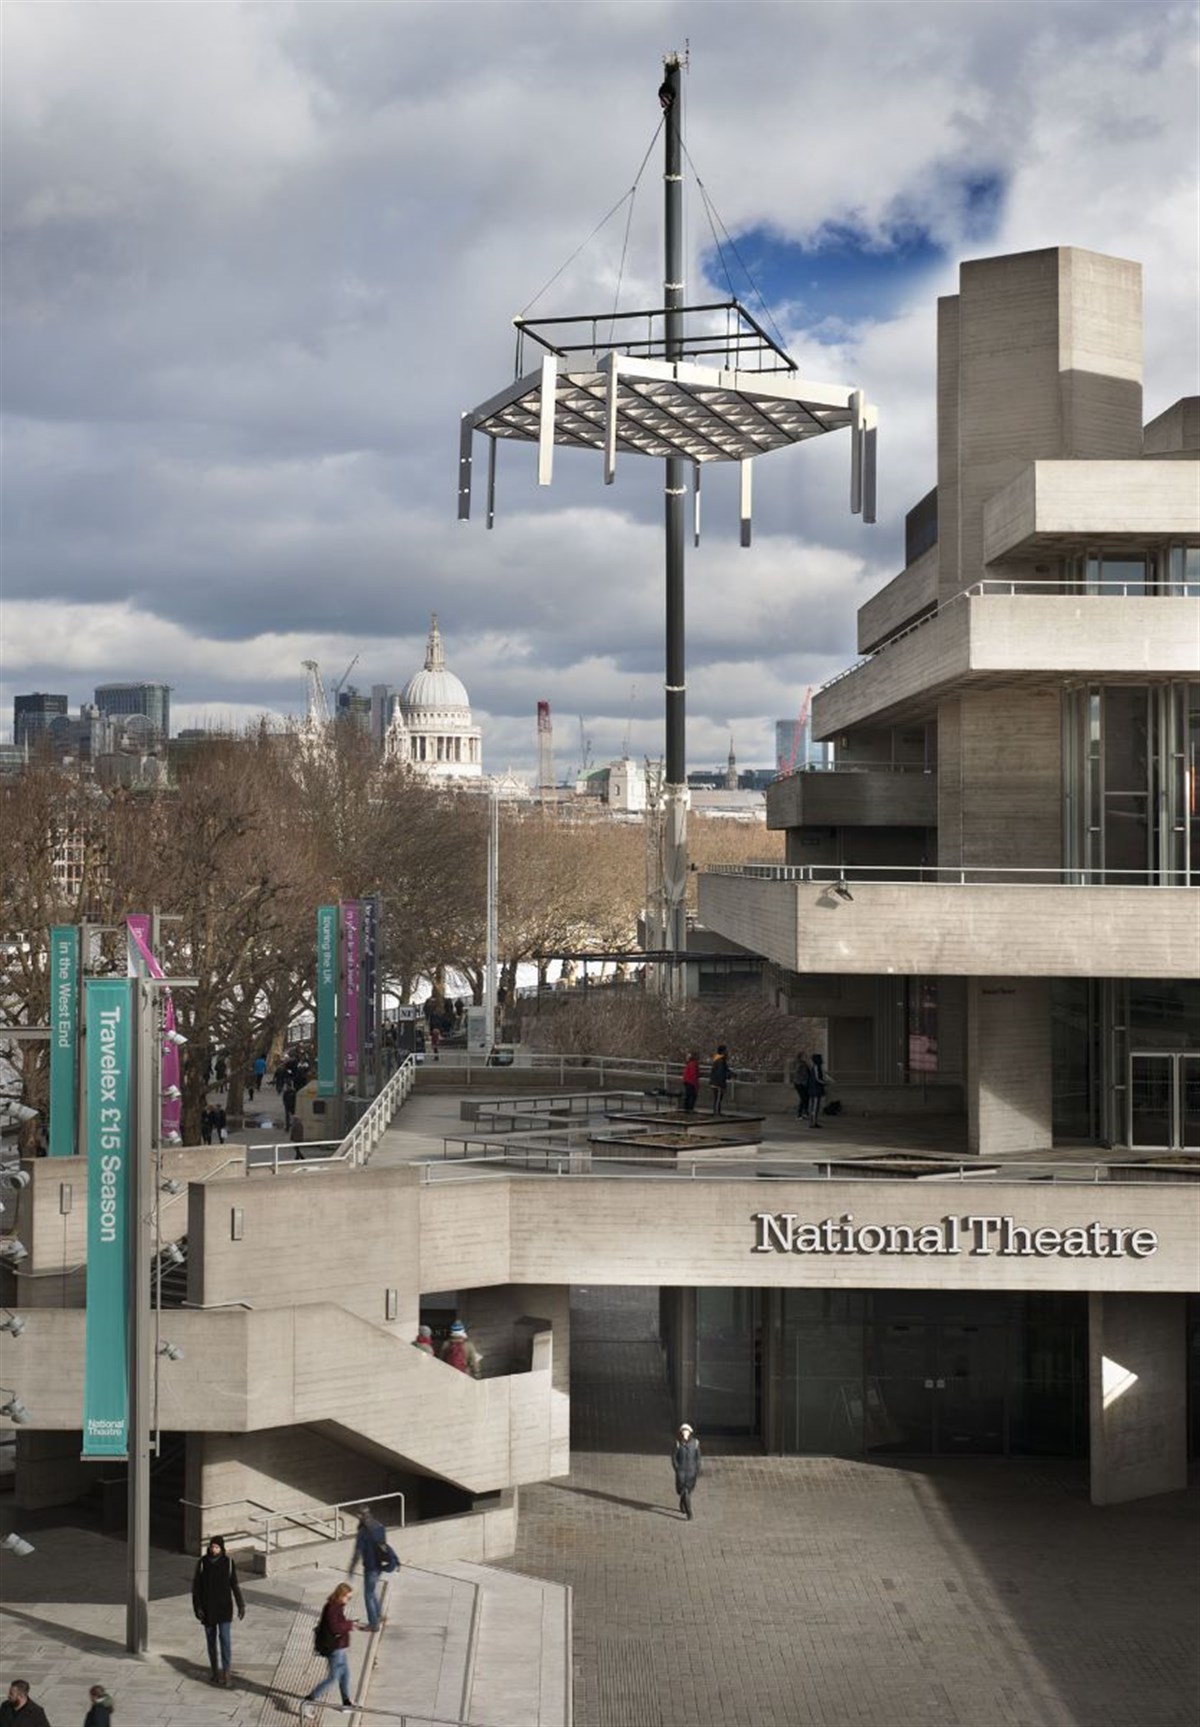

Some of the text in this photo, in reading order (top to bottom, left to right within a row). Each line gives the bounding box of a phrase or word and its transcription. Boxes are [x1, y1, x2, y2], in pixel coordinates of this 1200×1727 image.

[323, 951, 332, 967] the
[323, 968, 332, 985] UK
[59, 941, 72, 1048] in the West End
[100, 1006, 121, 1242] Travelex £15 Season
[755, 1212, 1159, 1257] National Theatre
[88, 1419, 124, 1428] National
[88, 1427, 122, 1436] Theatre
